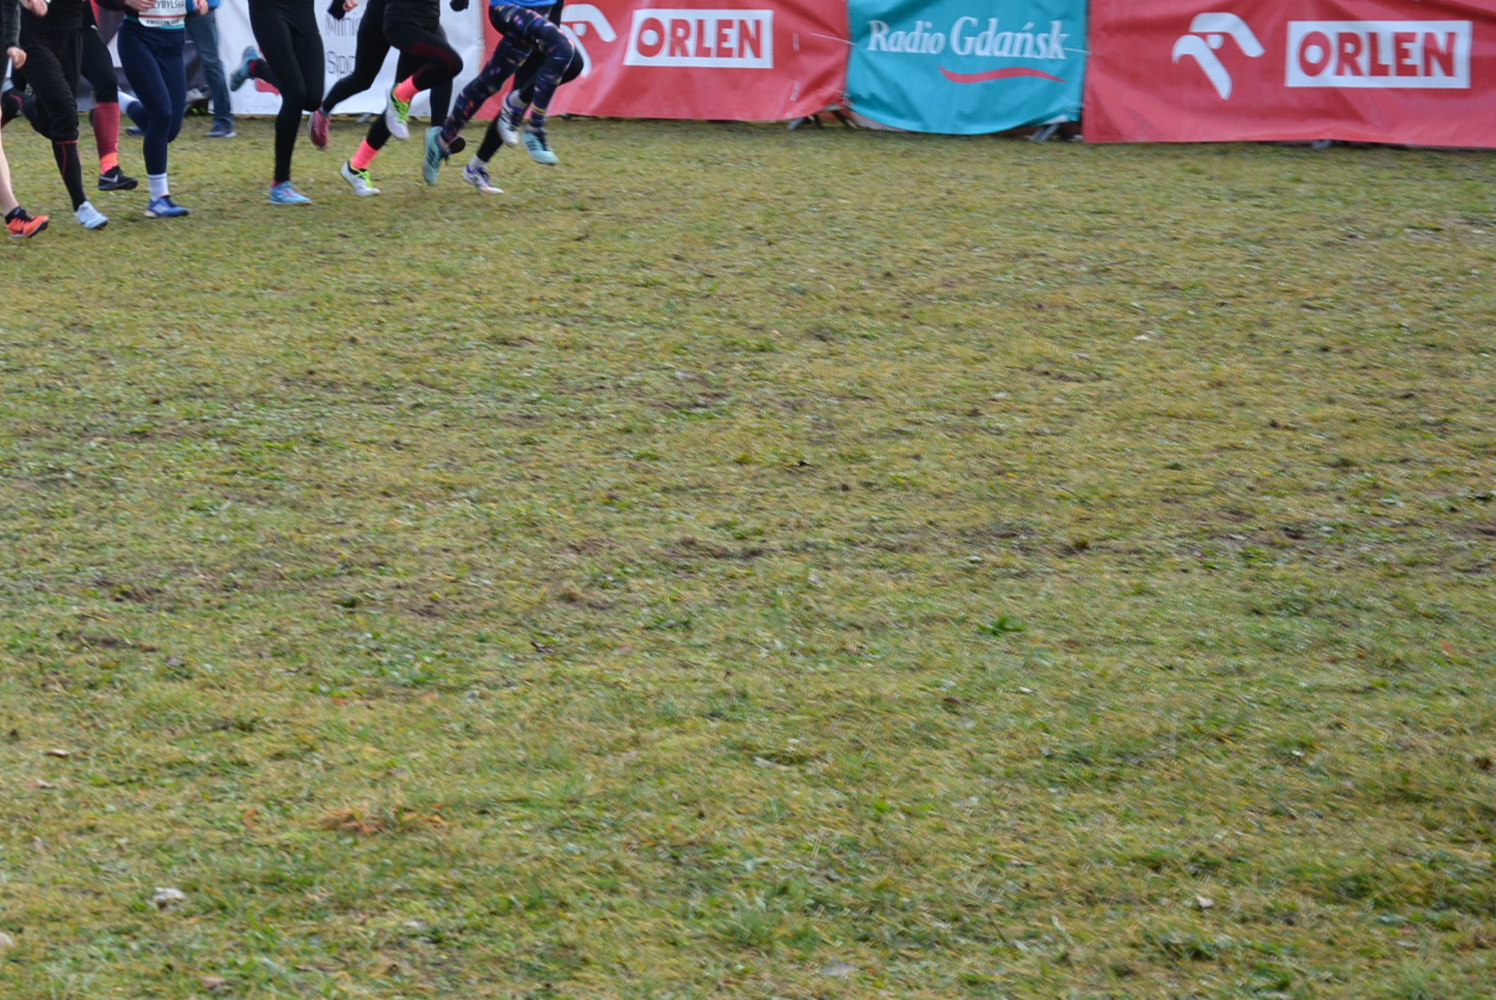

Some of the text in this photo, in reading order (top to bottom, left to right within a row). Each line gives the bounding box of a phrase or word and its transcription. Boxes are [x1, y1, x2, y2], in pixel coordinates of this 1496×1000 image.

[637, 17, 763, 59] ORLEN
[867, 16, 1070, 60] Radio Gdańsk
[1299, 31, 1457, 77] ORLEN
